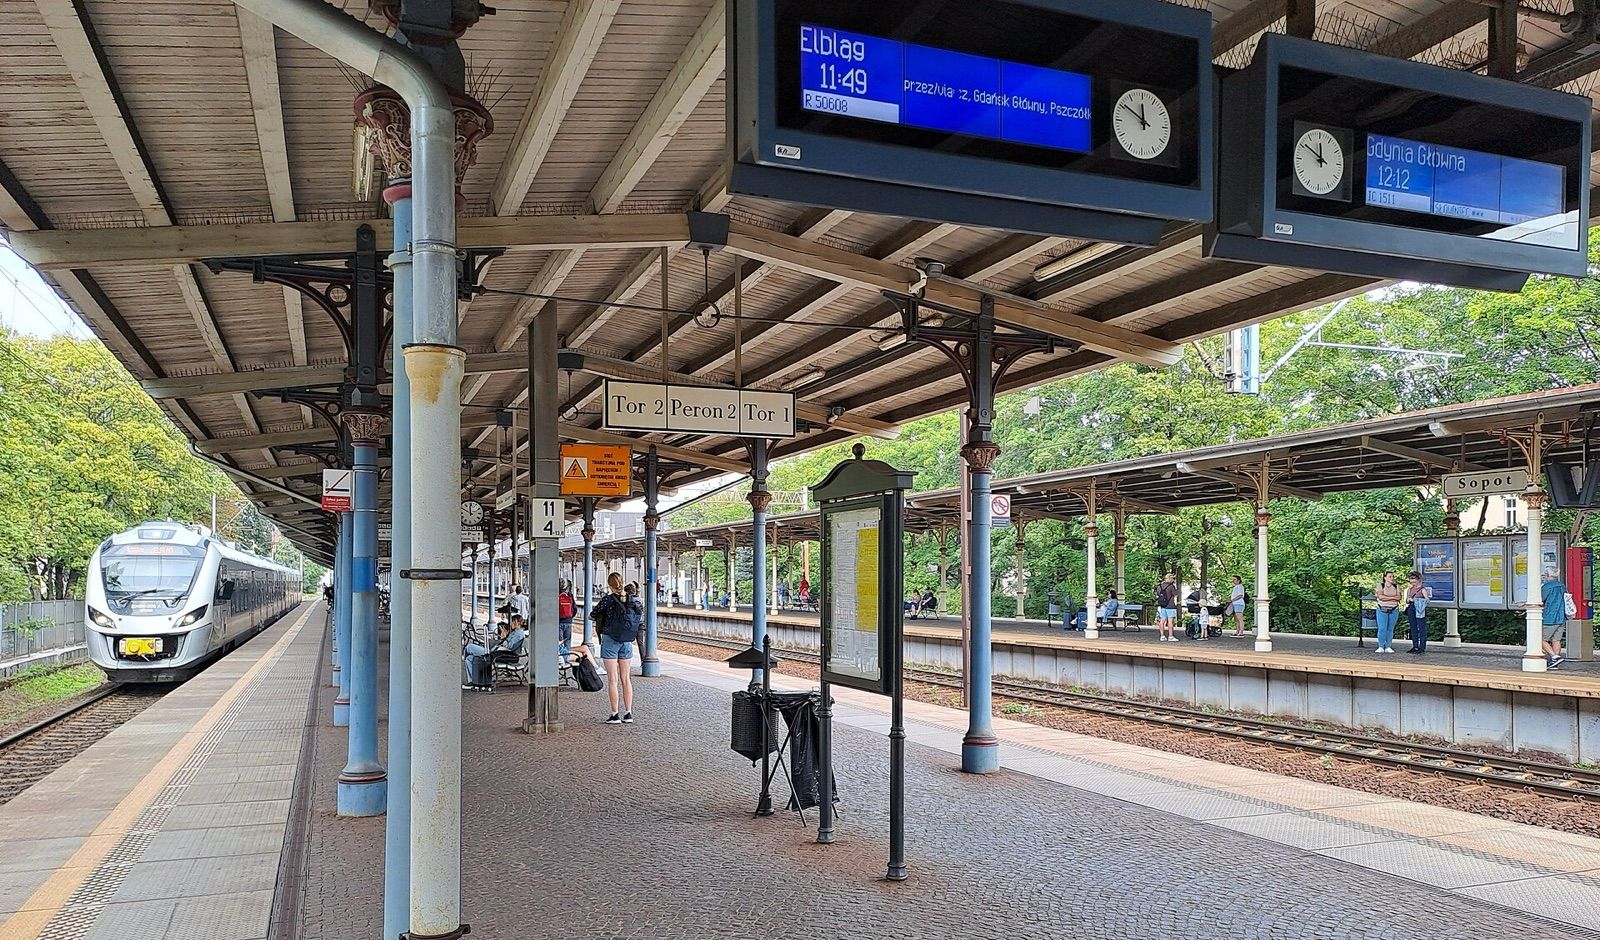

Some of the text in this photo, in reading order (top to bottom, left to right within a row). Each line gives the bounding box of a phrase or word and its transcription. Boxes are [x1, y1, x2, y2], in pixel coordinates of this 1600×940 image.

[800, 25, 865, 62] Elbląg
[820, 62, 867, 95] 11:49
[805, 93, 848, 112] R 50608
[973, 89, 1010, 107] Gdańsk
[1012, 95, 1049, 114] Główny,
[1367, 135, 1466, 172] Gdynia Główna
[1378, 165, 1410, 190] 12:12
[1368, 190, 1396, 205] IC 1511
[612, 395, 664, 416] Tor 2
[670, 398, 737, 420] Peron 2
[743, 403, 790, 423] Tor 1
[1458, 475, 1513, 491] Sopot
[543, 500, 555, 517] 11
[543, 520, 553, 536] 4
